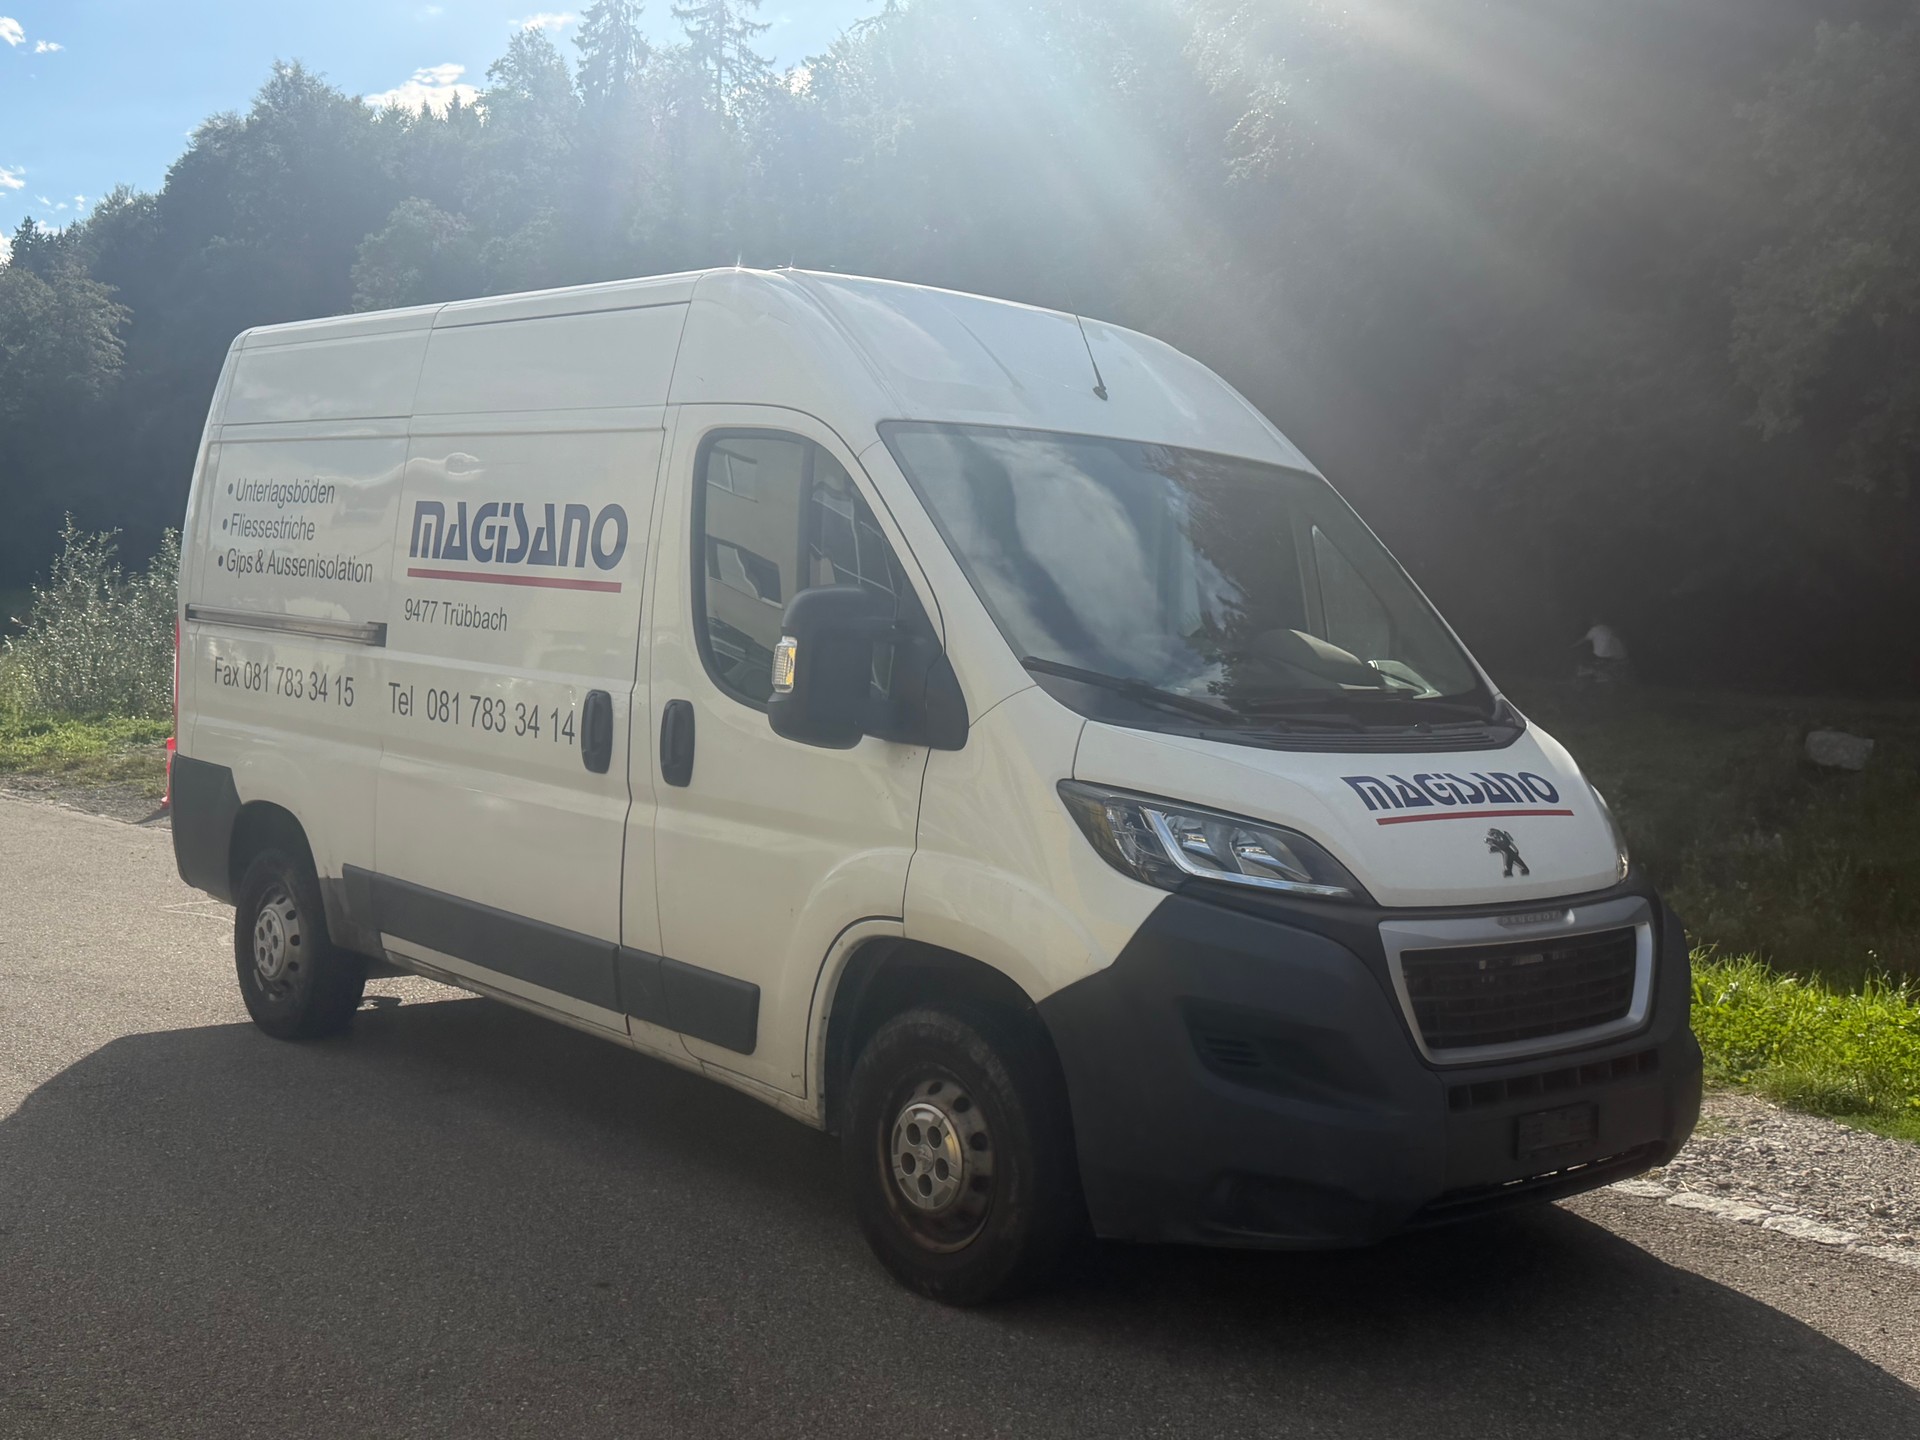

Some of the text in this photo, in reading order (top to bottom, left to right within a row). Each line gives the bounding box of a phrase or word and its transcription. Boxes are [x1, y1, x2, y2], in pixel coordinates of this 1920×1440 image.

[235, 478, 335, 509] Unterlagsböden
[230, 512, 315, 541] Fliessestriche
[226, 547, 373, 583] Gips & Aussenisolation
[404, 598, 508, 632] 9477 Trübbach
[214, 656, 355, 707] Fax 081 783 34 15
[388, 682, 576, 745] Tel 081 783 34 14
